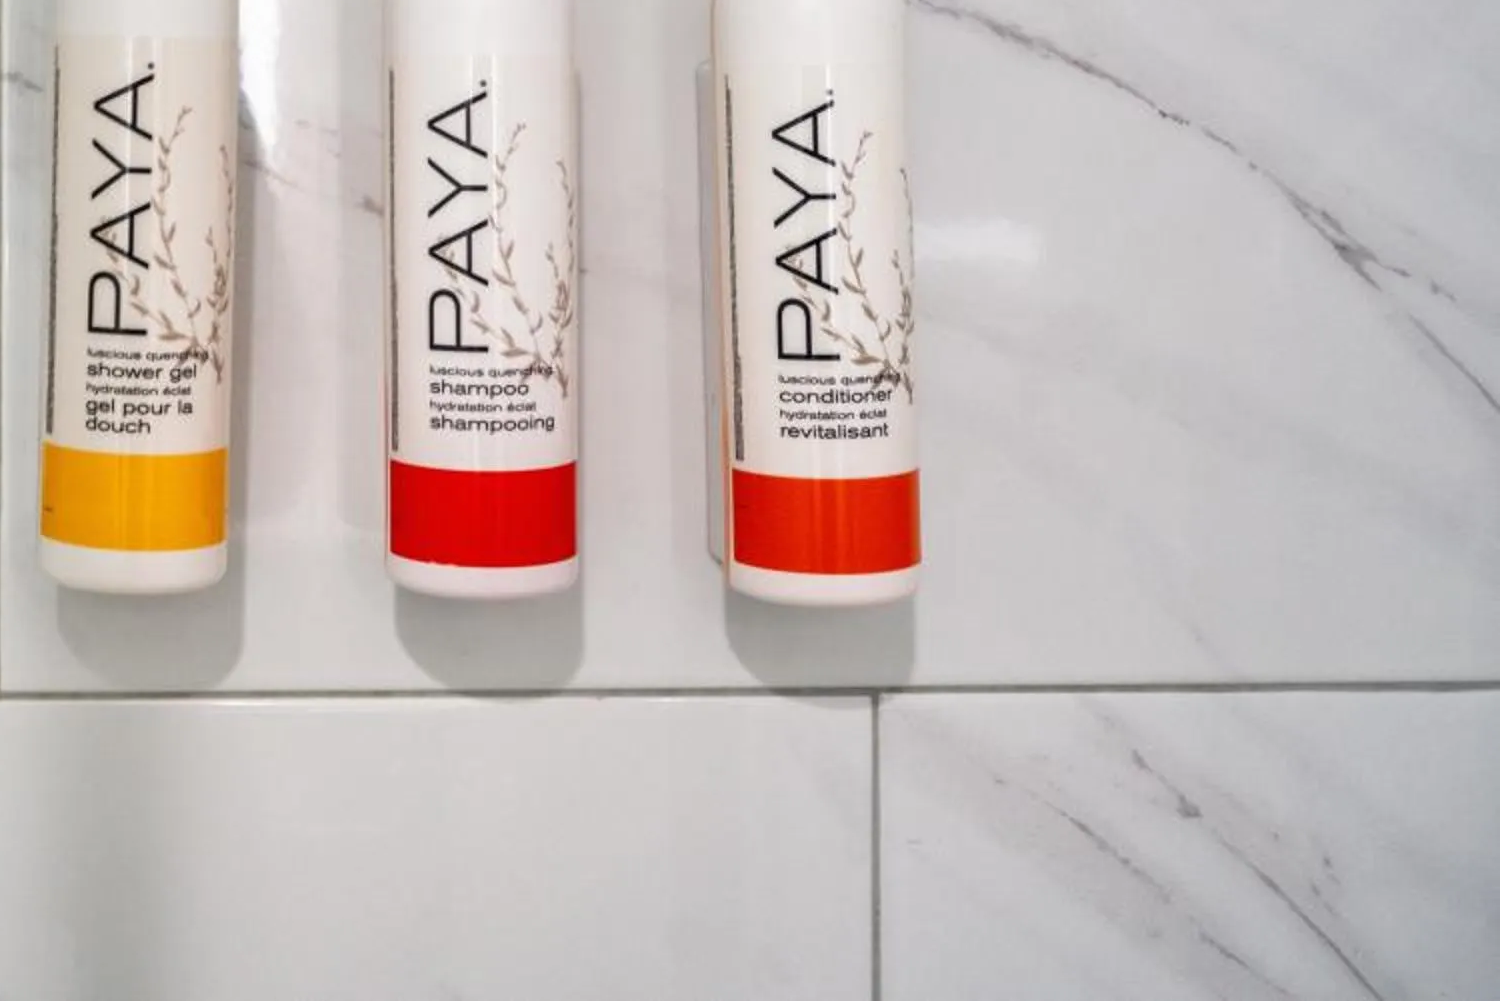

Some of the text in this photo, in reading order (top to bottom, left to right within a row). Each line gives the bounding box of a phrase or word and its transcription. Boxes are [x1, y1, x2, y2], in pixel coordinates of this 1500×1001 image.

[87, 347, 142, 360] luscious
[86, 363, 197, 383] shower gel
[429, 364, 484, 377] luscious
[779, 374, 837, 386] luscious
[429, 379, 530, 399] shampoo
[779, 388, 893, 404] conditioner
[85, 399, 193, 417] gel pour la
[85, 417, 151, 433] douch
[429, 415, 555, 435] shampooing
[780, 423, 890, 439] revitalisant
